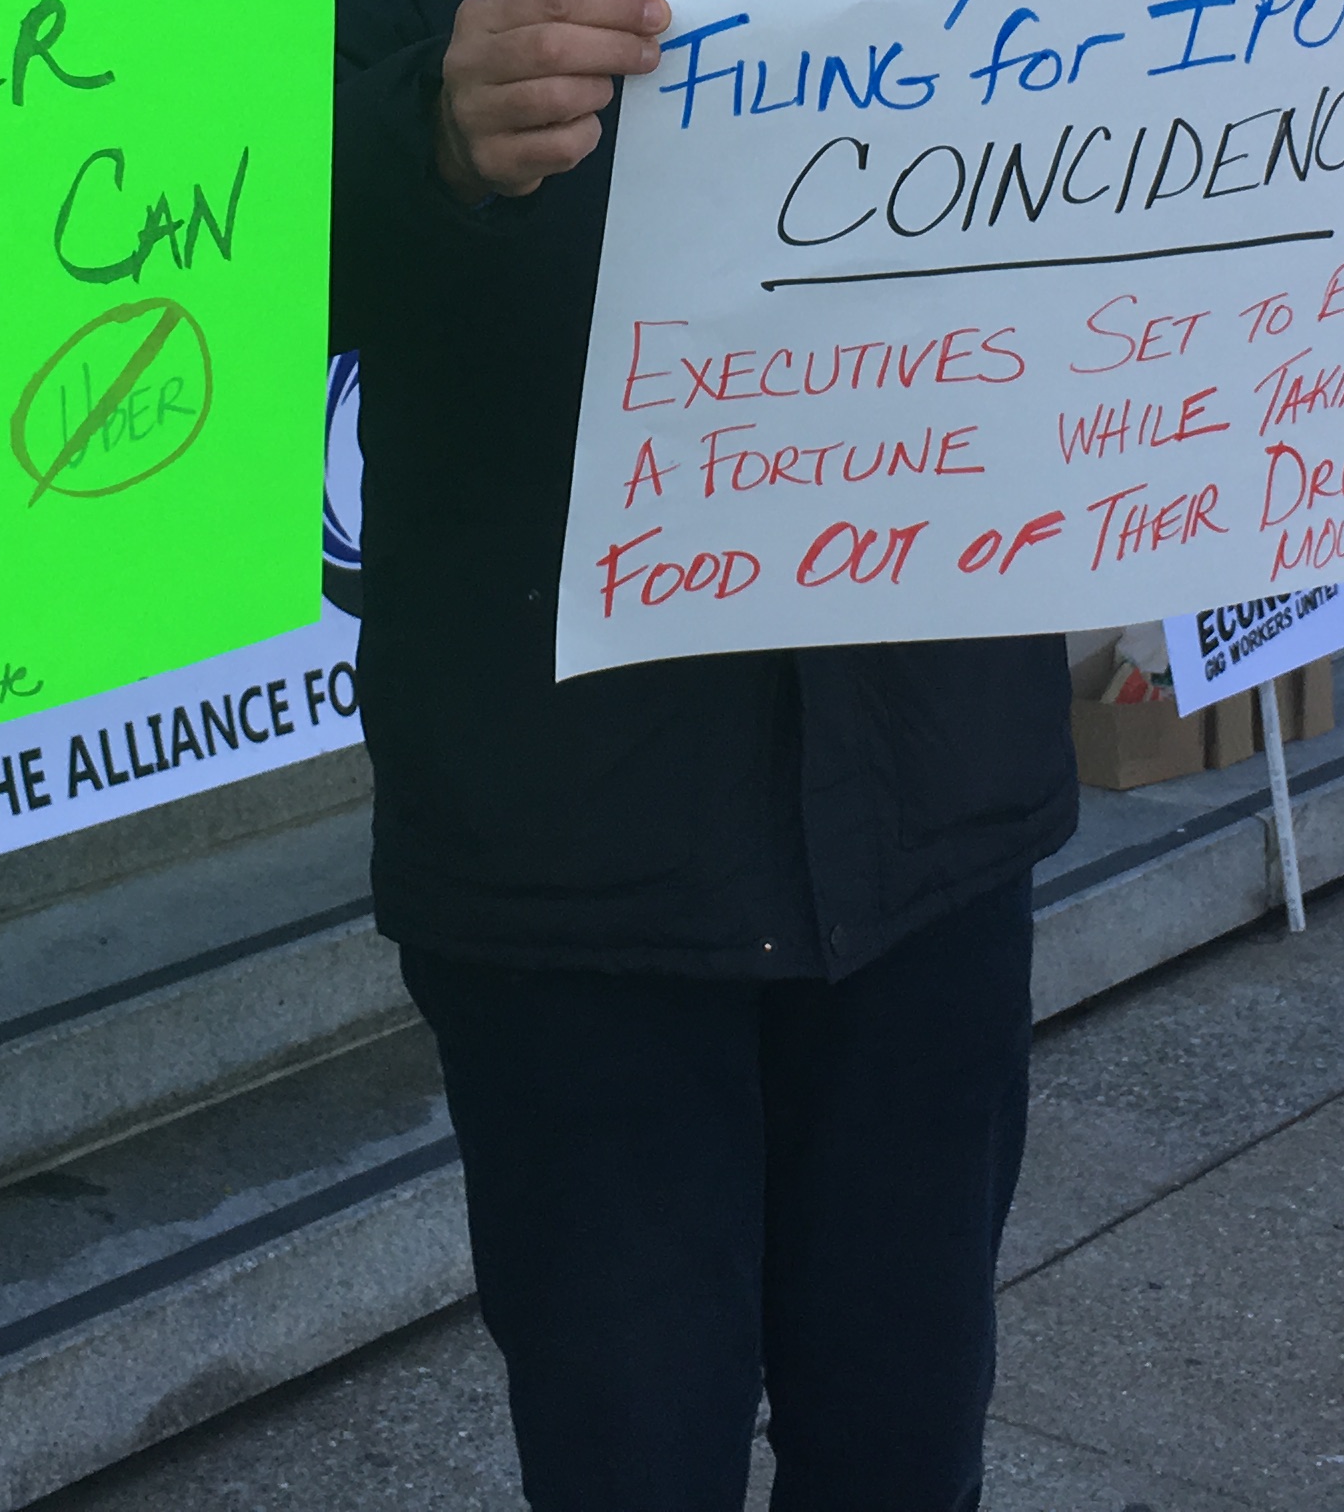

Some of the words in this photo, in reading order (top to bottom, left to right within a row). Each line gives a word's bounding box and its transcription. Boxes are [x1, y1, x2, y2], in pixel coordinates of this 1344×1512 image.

[658, 12, 939, 130] FILING
[971, 7, 1125, 106] for
[622, 319, 1026, 413] EXECUTIVES
[1069, 294, 1212, 375] SET
[1238, 291, 1294, 343] TO
[623, 439, 682, 509] A
[700, 422, 987, 494] FORTUNE
[1057, 385, 1231, 466] WHILE
[596, 526, 762, 619] FOOD
[795, 518, 931, 590] OUT
[958, 510, 1069, 576] OF
[1087, 481, 1231, 574] THEIR
[1228, 605, 1294, 665] WORKERS
[66, 679, 296, 799] ALLIANCE
